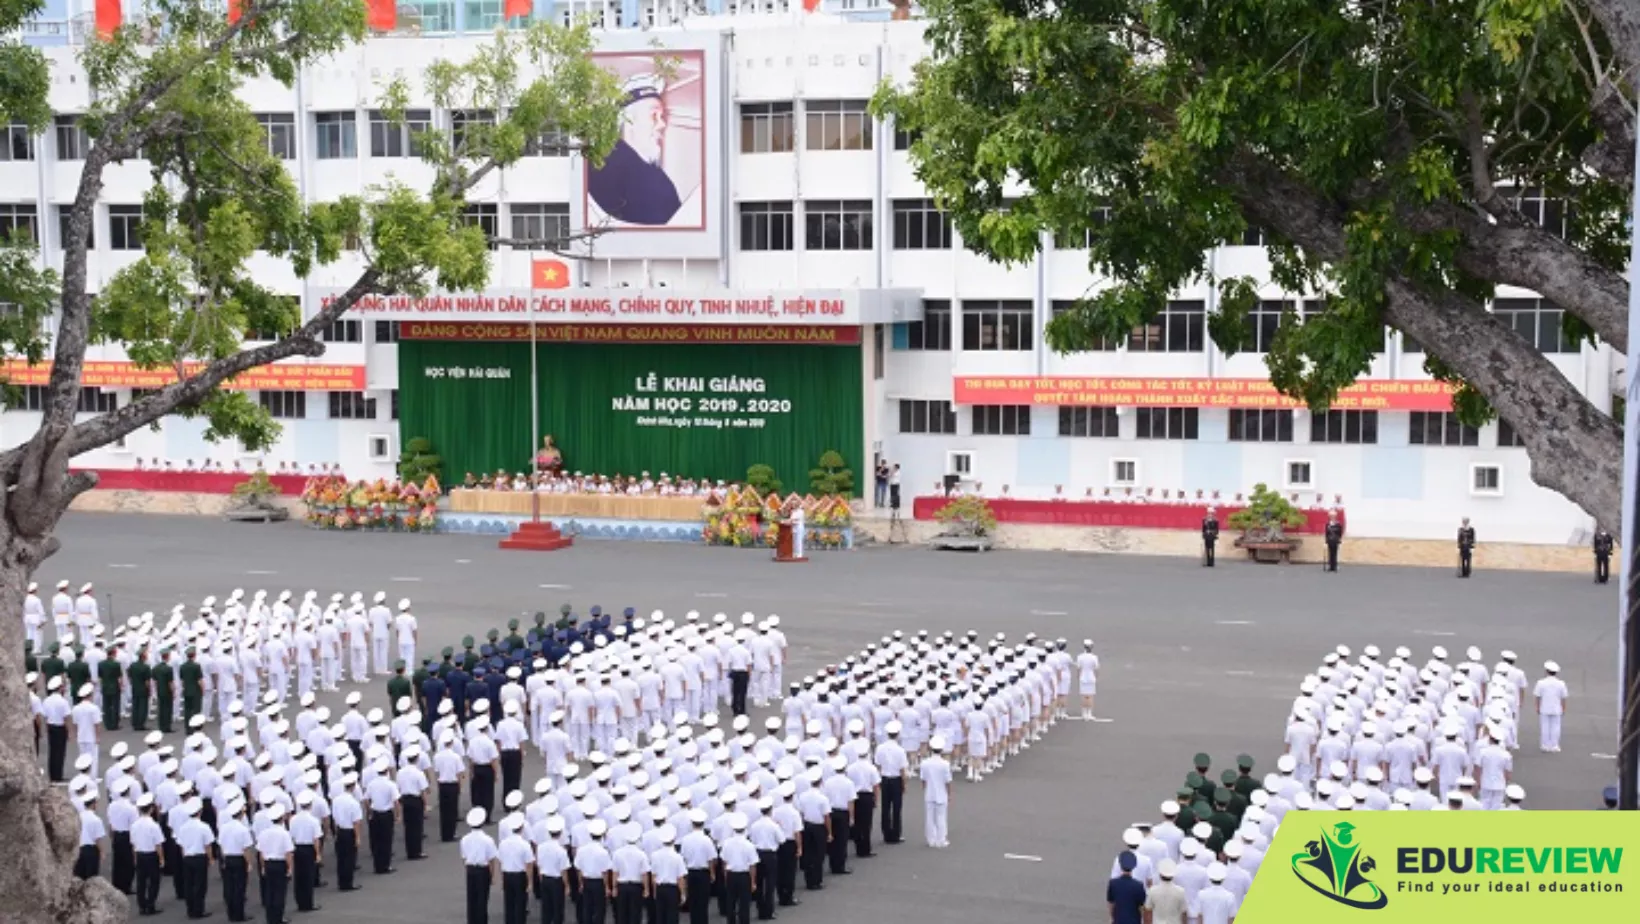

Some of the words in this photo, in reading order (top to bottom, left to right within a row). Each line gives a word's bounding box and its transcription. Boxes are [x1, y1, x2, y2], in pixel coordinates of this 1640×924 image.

[416, 294, 453, 313] QUÂN
[457, 293, 493, 312] NHÂN
[499, 295, 526, 312] DÂN
[532, 295, 565, 313] CÁCH
[570, 299, 616, 316] MẠNG,
[619, 295, 661, 314] CHÍNH
[665, 299, 696, 316] QUY,
[700, 299, 731, 314] TINH
[735, 295, 779, 318] NHUỆ,
[783, 295, 816, 318] HIỆN
[820, 299, 844, 316] ĐẠI
[411, 323, 457, 337] ĐẢNG
[461, 323, 512, 339] CỘNG
[549, 325, 581, 340] VIỆT
[584, 327, 622, 339] NAM
[626, 327, 688, 340] QUANG
[693, 327, 732, 340] VINH
[737, 326, 790, 340] MUÔN
[795, 326, 835, 340] NĂM
[425, 366, 445, 379] HỌC
[447, 365, 466, 379] VIỆN
[485, 365, 511, 378] QUÂN
[636, 371, 657, 391] LỄ
[663, 377, 704, 392] KHAI
[1059, 379, 1082, 391] HỌC
[1146, 379, 1168, 390] TÁC
[1216, 379, 1244, 391] LUẬT
[1371, 381, 1409, 393] CHIẾN
[612, 394, 650, 410] NĂM
[654, 397, 691, 414] HỌC
[1034, 391, 1069, 404] QUYẾT
[1073, 392, 1096, 403] TÂM
[1100, 392, 1132, 404] HOÀN
[1136, 393, 1173, 404] THÀNH
[1177, 393, 1206, 404] XUẤT
[1210, 393, 1233, 405] SẮC
